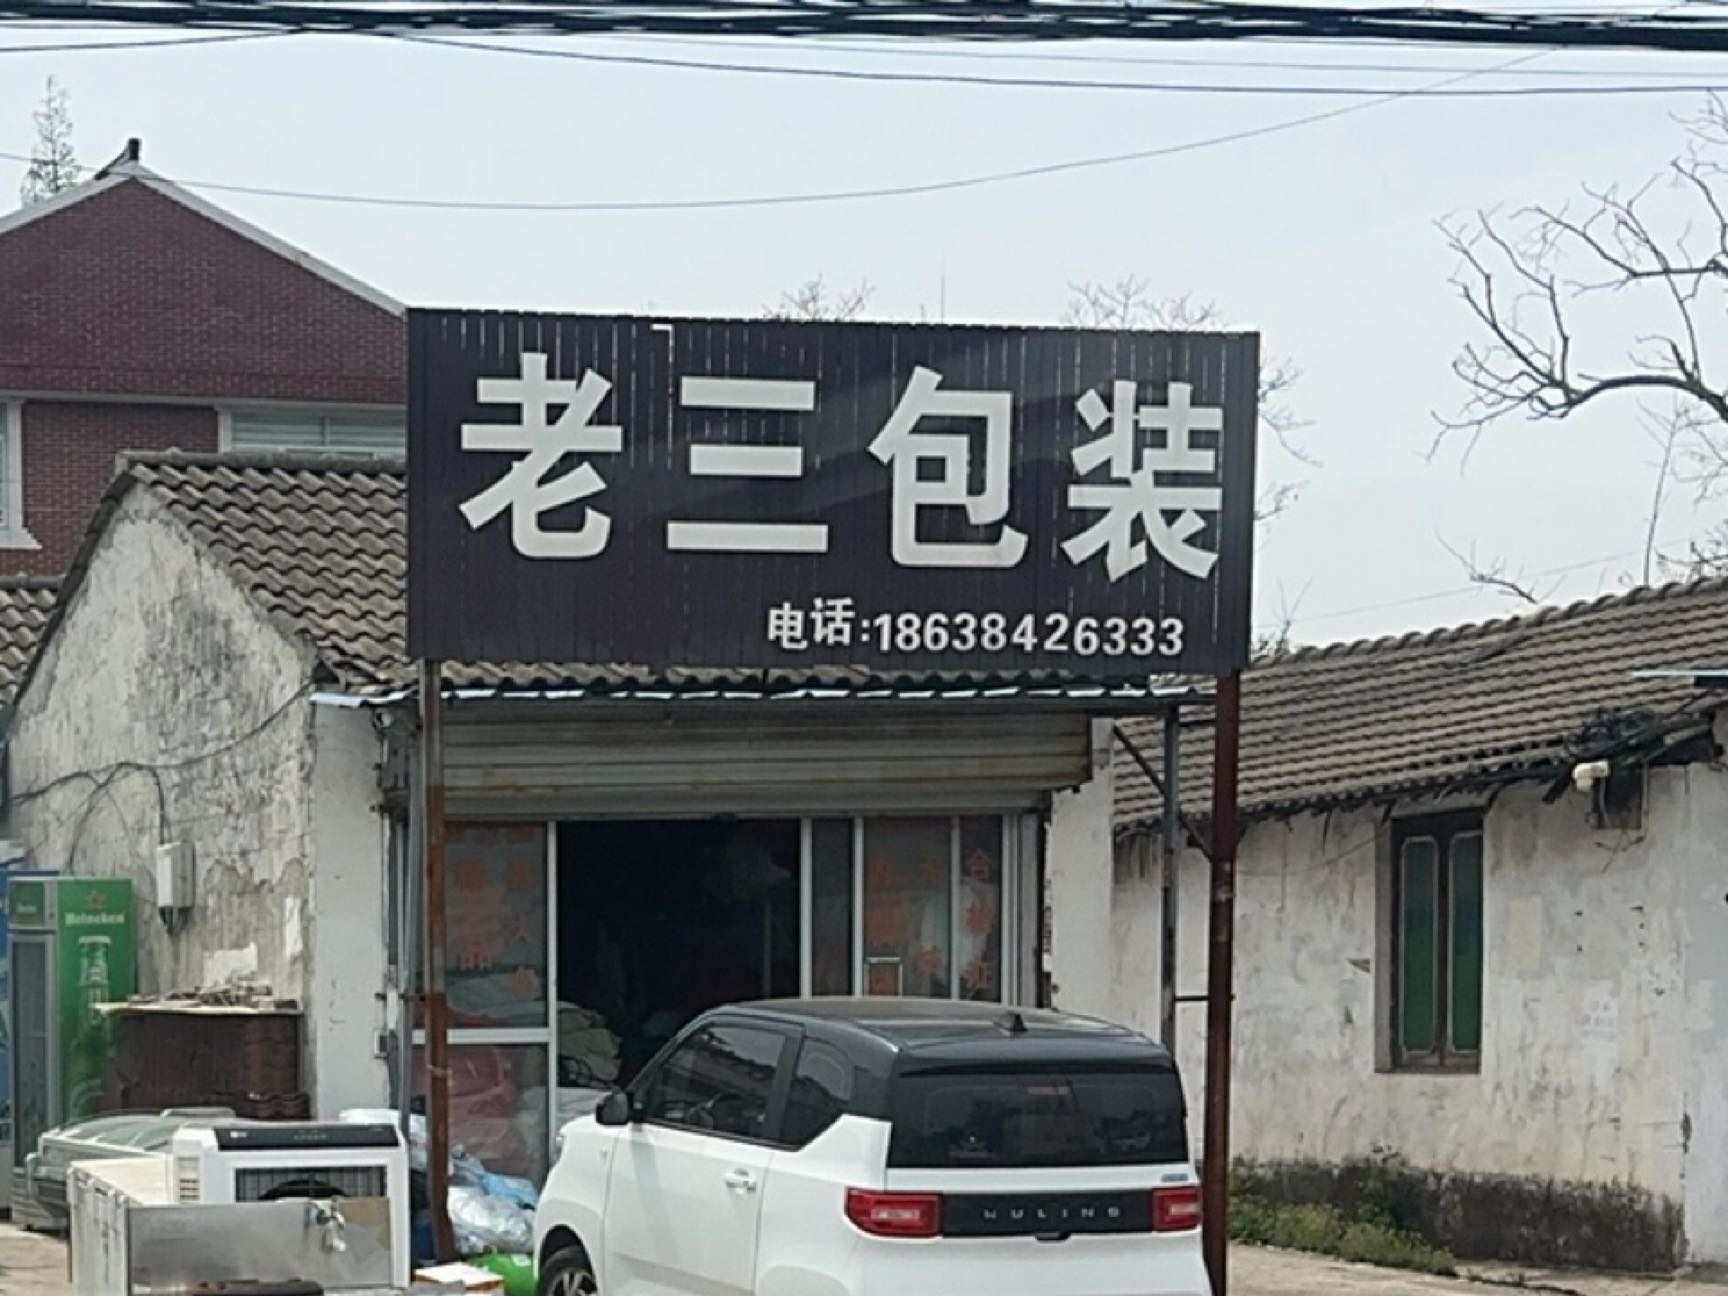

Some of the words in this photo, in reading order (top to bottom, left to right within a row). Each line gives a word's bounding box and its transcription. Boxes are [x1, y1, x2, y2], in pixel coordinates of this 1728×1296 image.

[459, 352, 1224, 583] 老三包装
[767, 596, 1184, 656] 电话:18638426333
